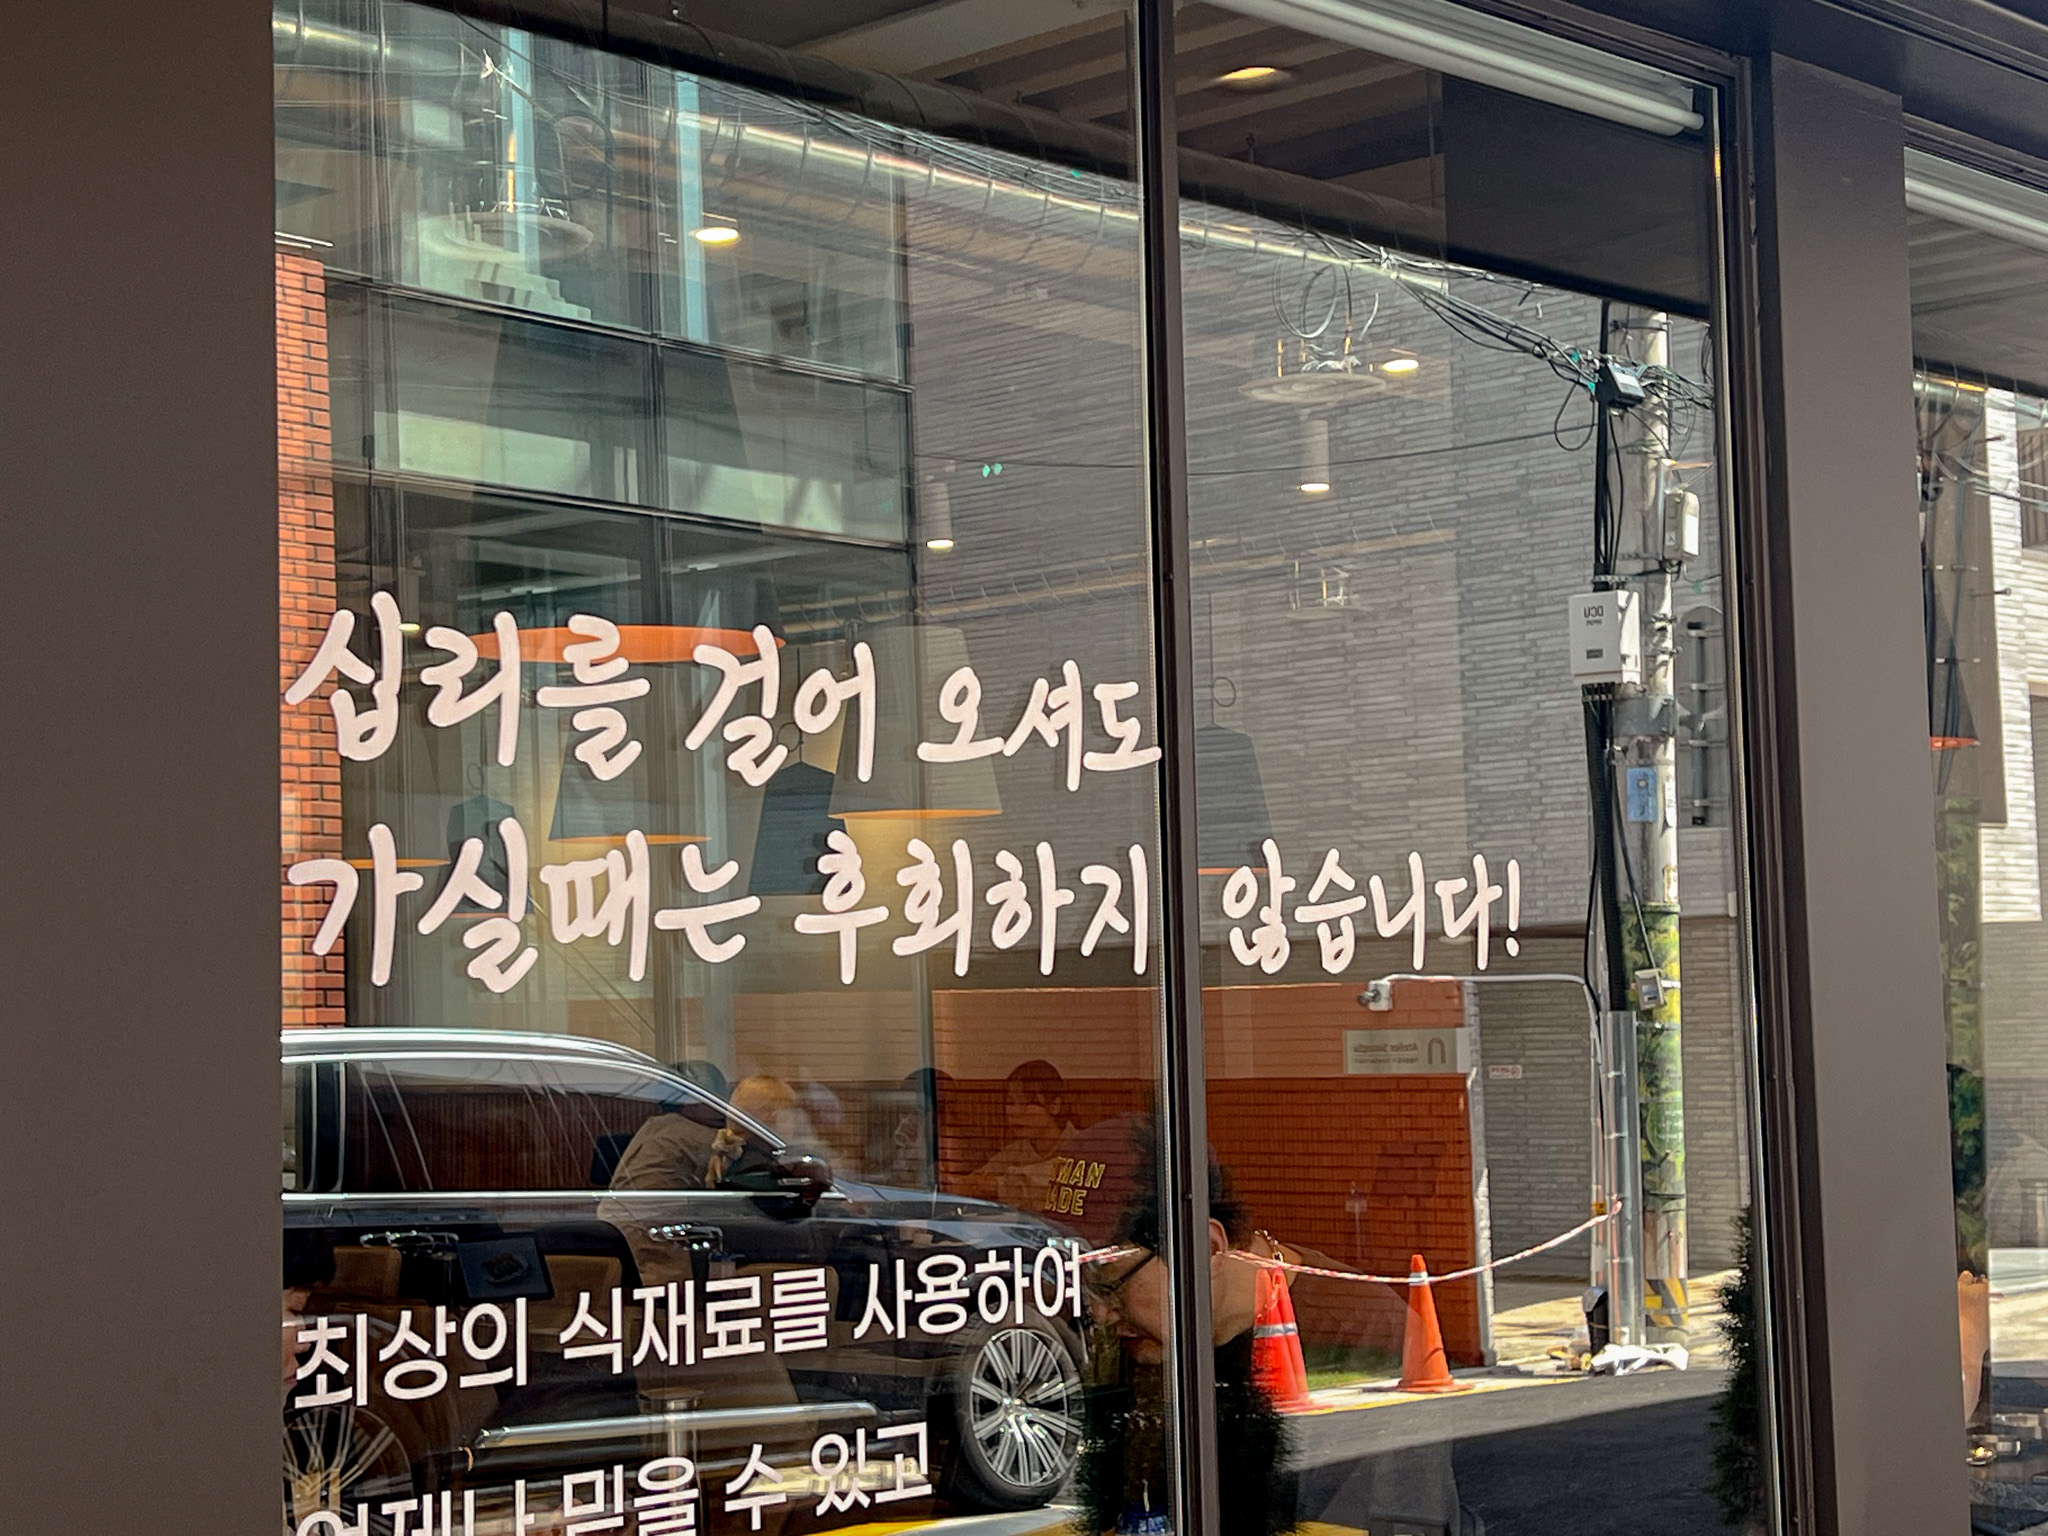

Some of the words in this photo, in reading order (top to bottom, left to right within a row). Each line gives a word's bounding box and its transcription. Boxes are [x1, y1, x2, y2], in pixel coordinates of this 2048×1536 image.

[283, 590, 652, 782] 십리를
[684, 623, 877, 788] 걸어
[916, 658, 1163, 793] 오셔도
[286, 816, 762, 994] 가실때는
[793, 829, 1149, 986] 후회하지
[1221, 837, 1522, 977] 않습니다!
[293, 1296, 529, 1411] 최상의
[558, 1266, 832, 1376] 식재료를
[853, 1240, 1083, 1340] 사용하여
[724, 1442, 788, 1532] 수
[810, 1420, 934, 1518] 있고
